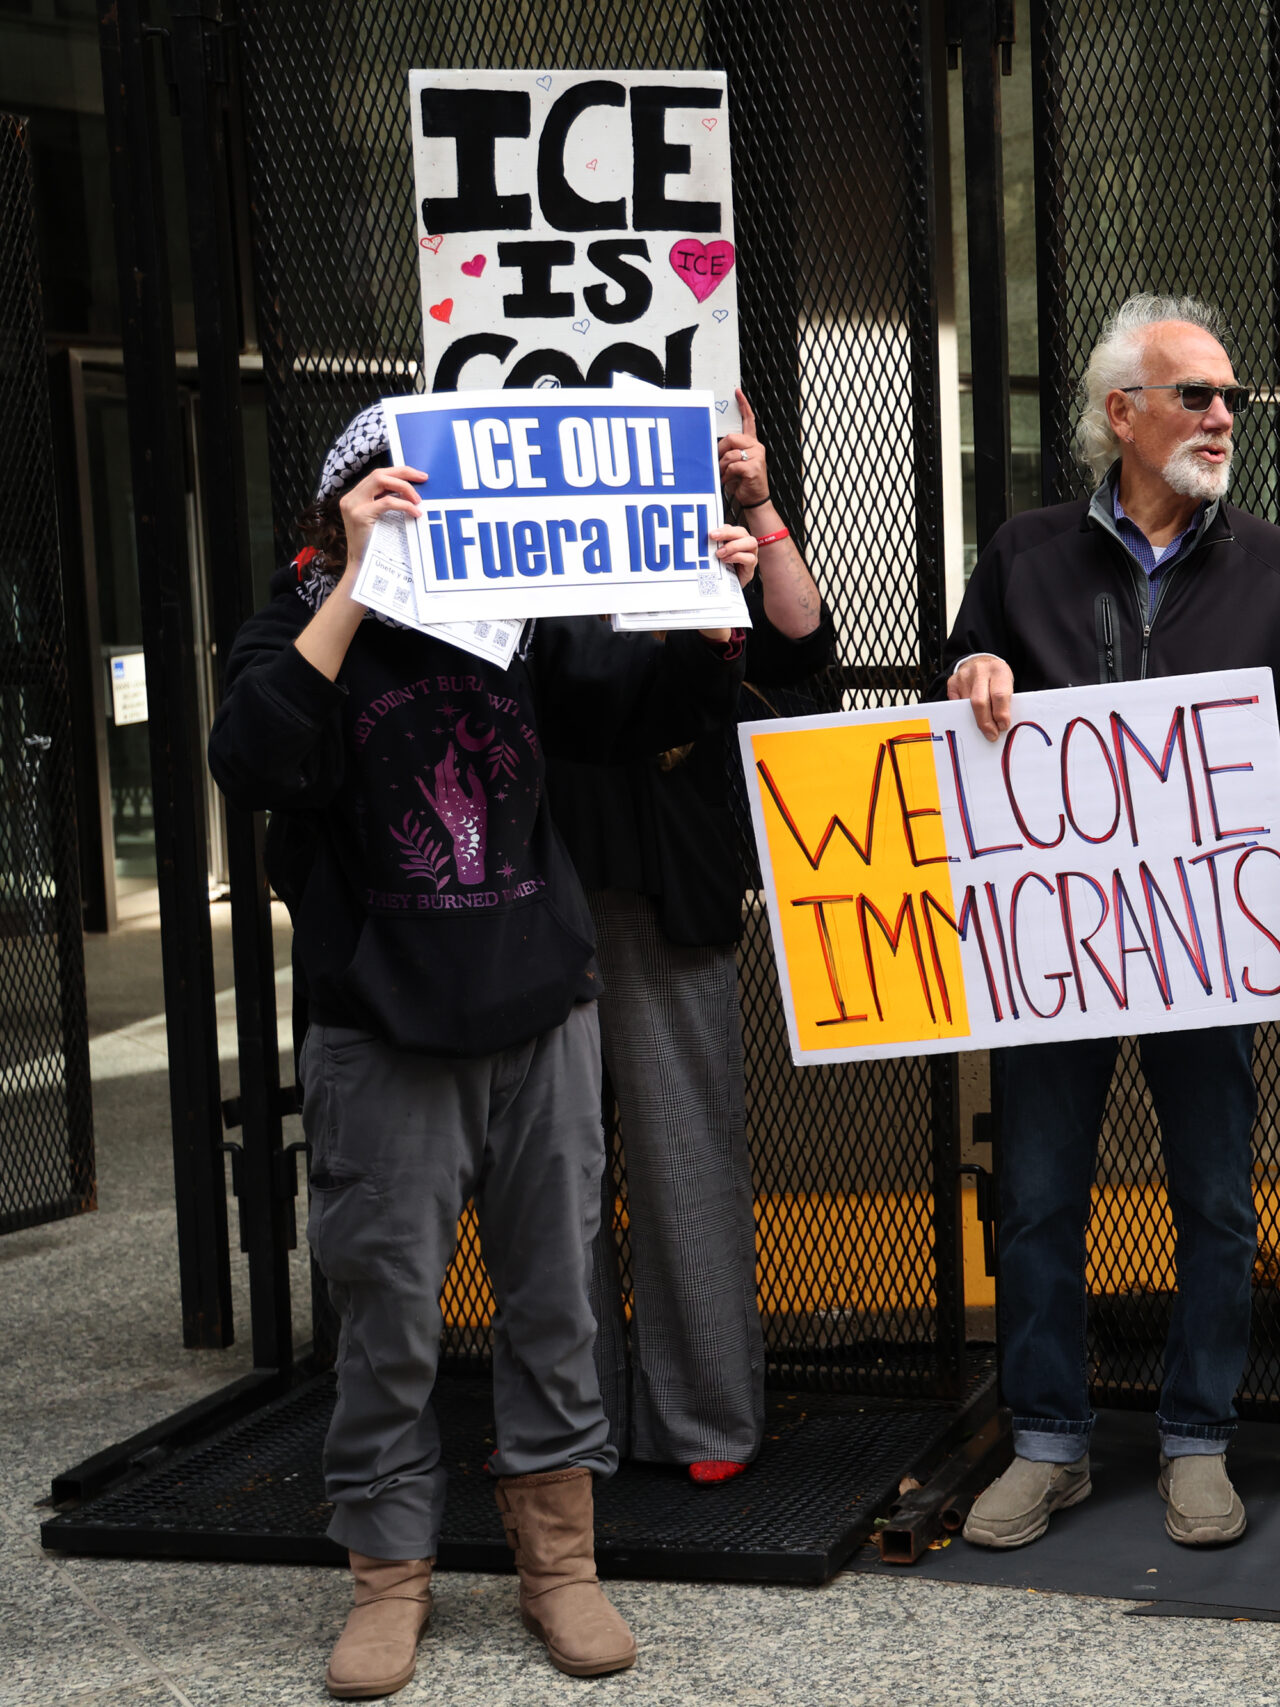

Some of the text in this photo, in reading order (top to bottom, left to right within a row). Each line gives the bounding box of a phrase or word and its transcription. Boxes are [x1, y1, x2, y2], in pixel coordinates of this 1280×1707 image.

[420, 79, 724, 236] ICE
[497, 239, 653, 325] IS
[677, 250, 727, 276] ICE
[452, 416, 676, 491] ICE OUT!
[427, 508, 613, 581] ¡Fuera
[624, 503, 711, 574] ICE!
[369, 678, 431, 717] DIDN'T
[757, 695, 1272, 870] WELCOME
[367, 888, 413, 911] THEY
[416, 891, 499, 910] BURNED
